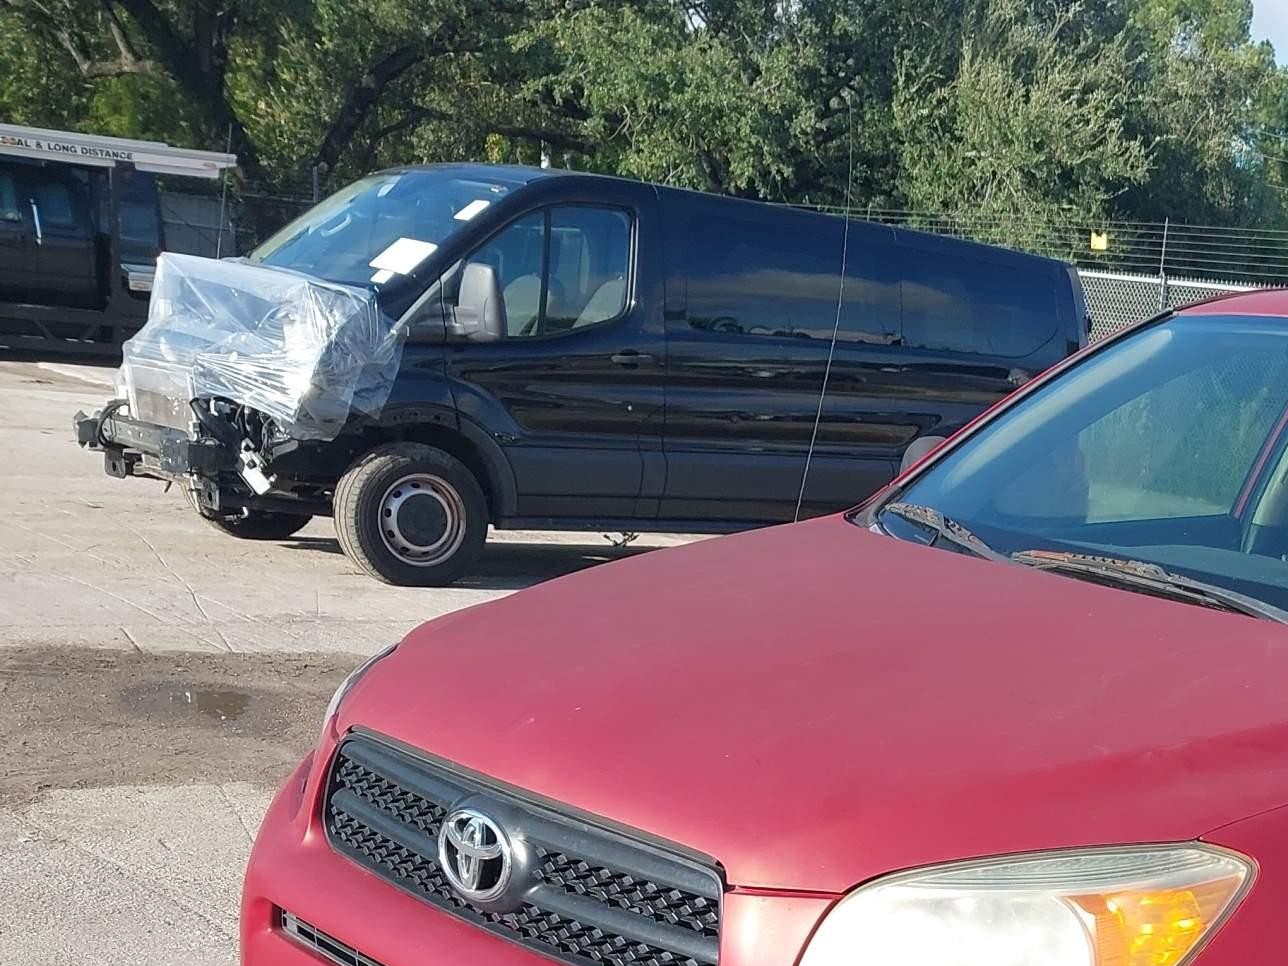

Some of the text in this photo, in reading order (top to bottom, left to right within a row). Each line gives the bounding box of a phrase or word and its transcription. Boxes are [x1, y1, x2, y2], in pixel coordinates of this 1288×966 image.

[35, 141, 43, 149] &
[47, 143, 77, 153] LONG
[81, 147, 133, 160] DISTANCE
